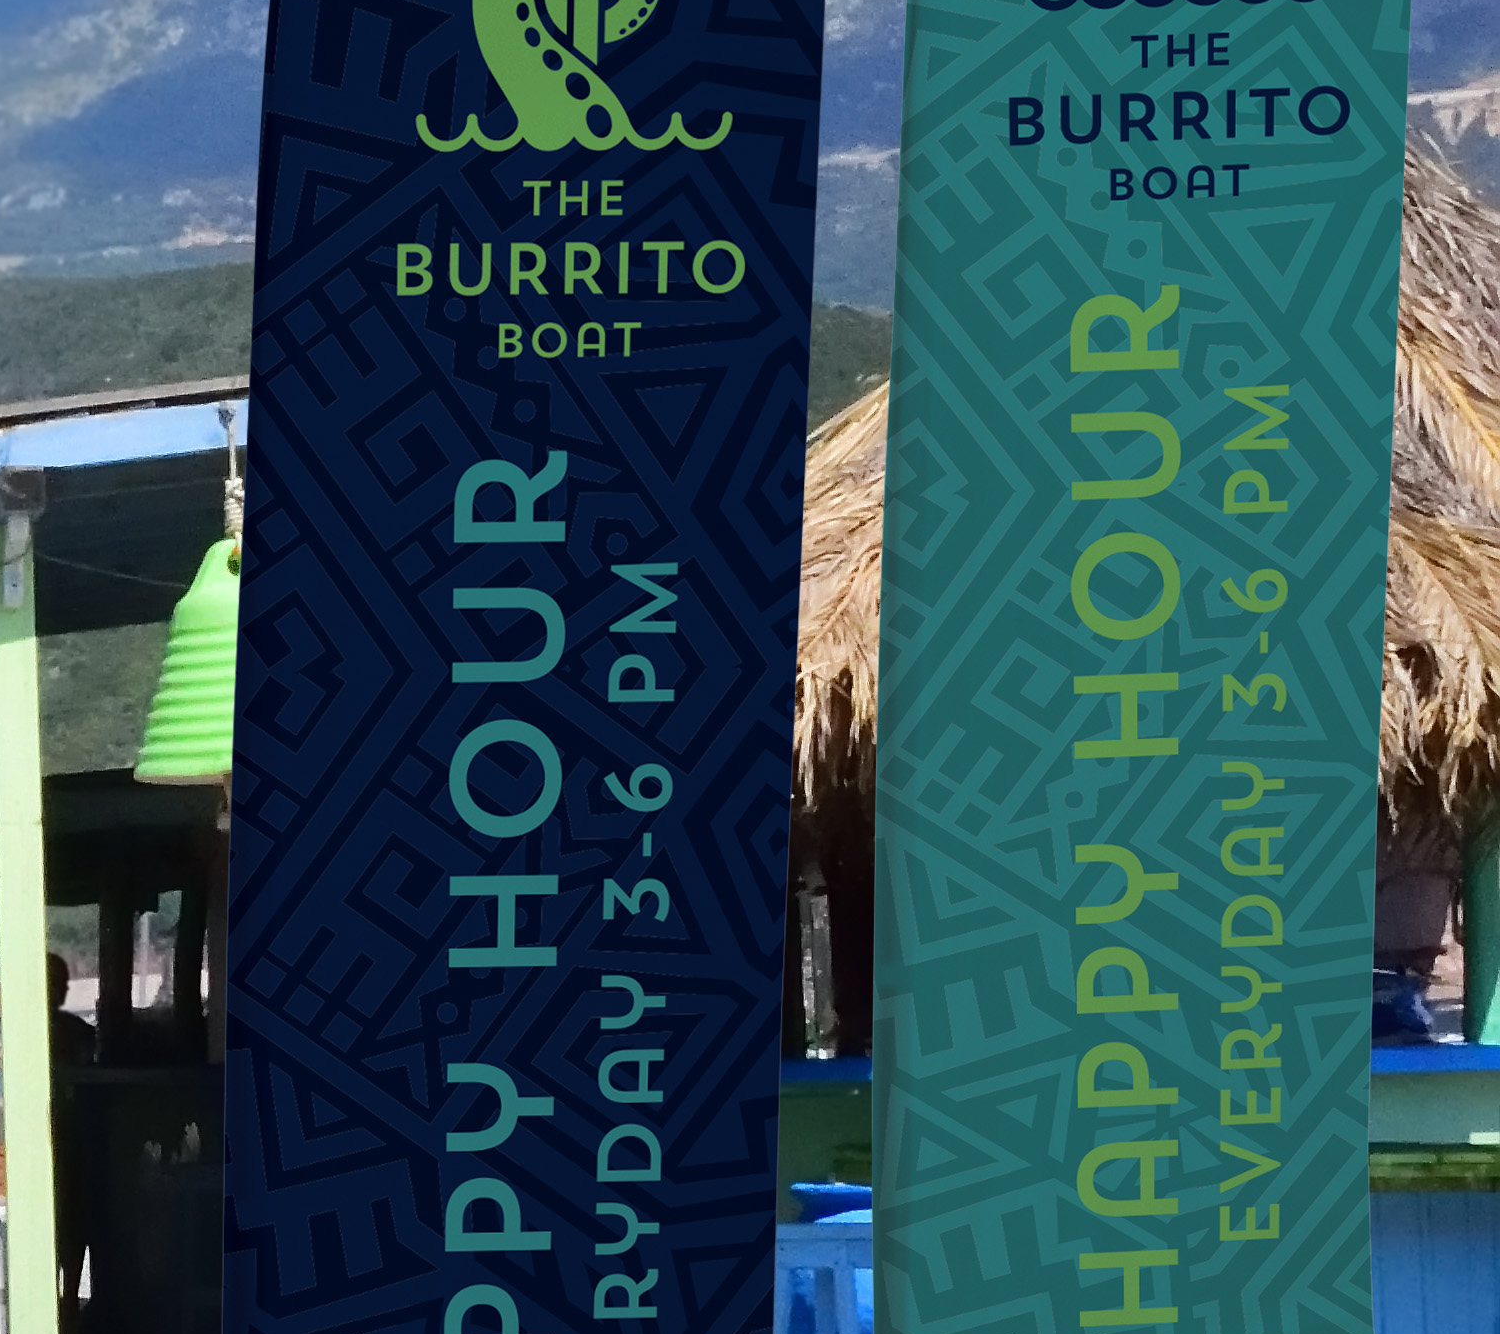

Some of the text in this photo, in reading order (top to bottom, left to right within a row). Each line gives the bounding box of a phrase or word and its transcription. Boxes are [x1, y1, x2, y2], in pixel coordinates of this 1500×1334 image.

[1131, 33, 1229, 68] THE
[1009, 86, 1350, 145] BURRITO
[524, 181, 623, 215] THE
[1111, 164, 1249, 200] BOAT
[397, 241, 745, 295] BURRITO
[499, 323, 641, 357] BOAT
[609, 563, 678, 702] PM
[449, 451, 567, 967] HOUR
[1070, 285, 1181, 1327] HAPPY HOUR
[1220, 385, 1289, 1241] EVERYDAY 3-6 PM
[604, 764, 672, 921] 3-6
